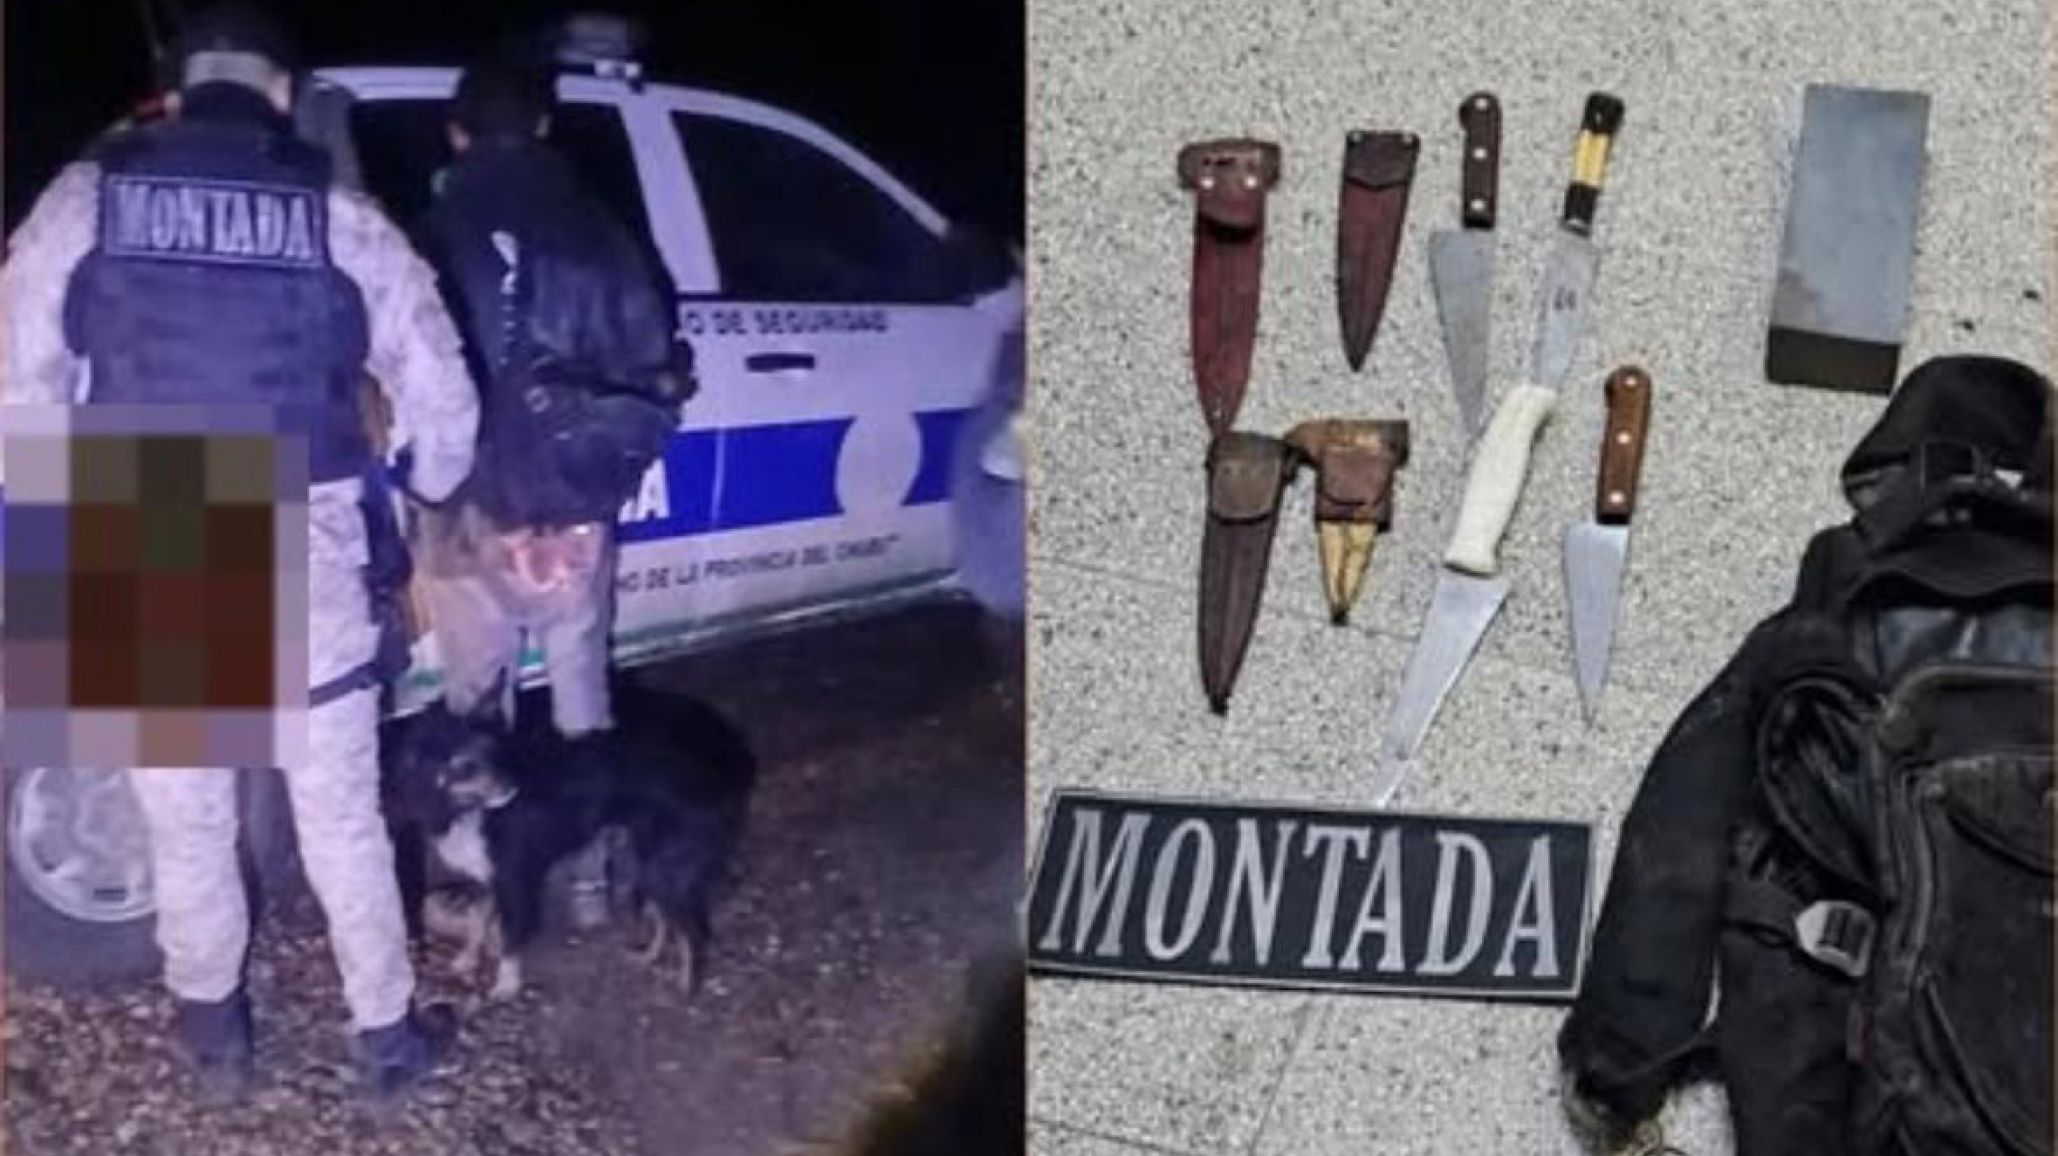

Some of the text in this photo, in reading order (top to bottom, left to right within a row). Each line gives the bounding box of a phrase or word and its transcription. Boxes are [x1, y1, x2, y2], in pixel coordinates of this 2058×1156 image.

[115, 183, 311, 260] MONTADA
[712, 309, 748, 335] DE
[617, 458, 671, 523] A
[645, 566, 670, 590] DE
[676, 564, 698, 584] LA
[1038, 808, 1561, 978] MONTADA
